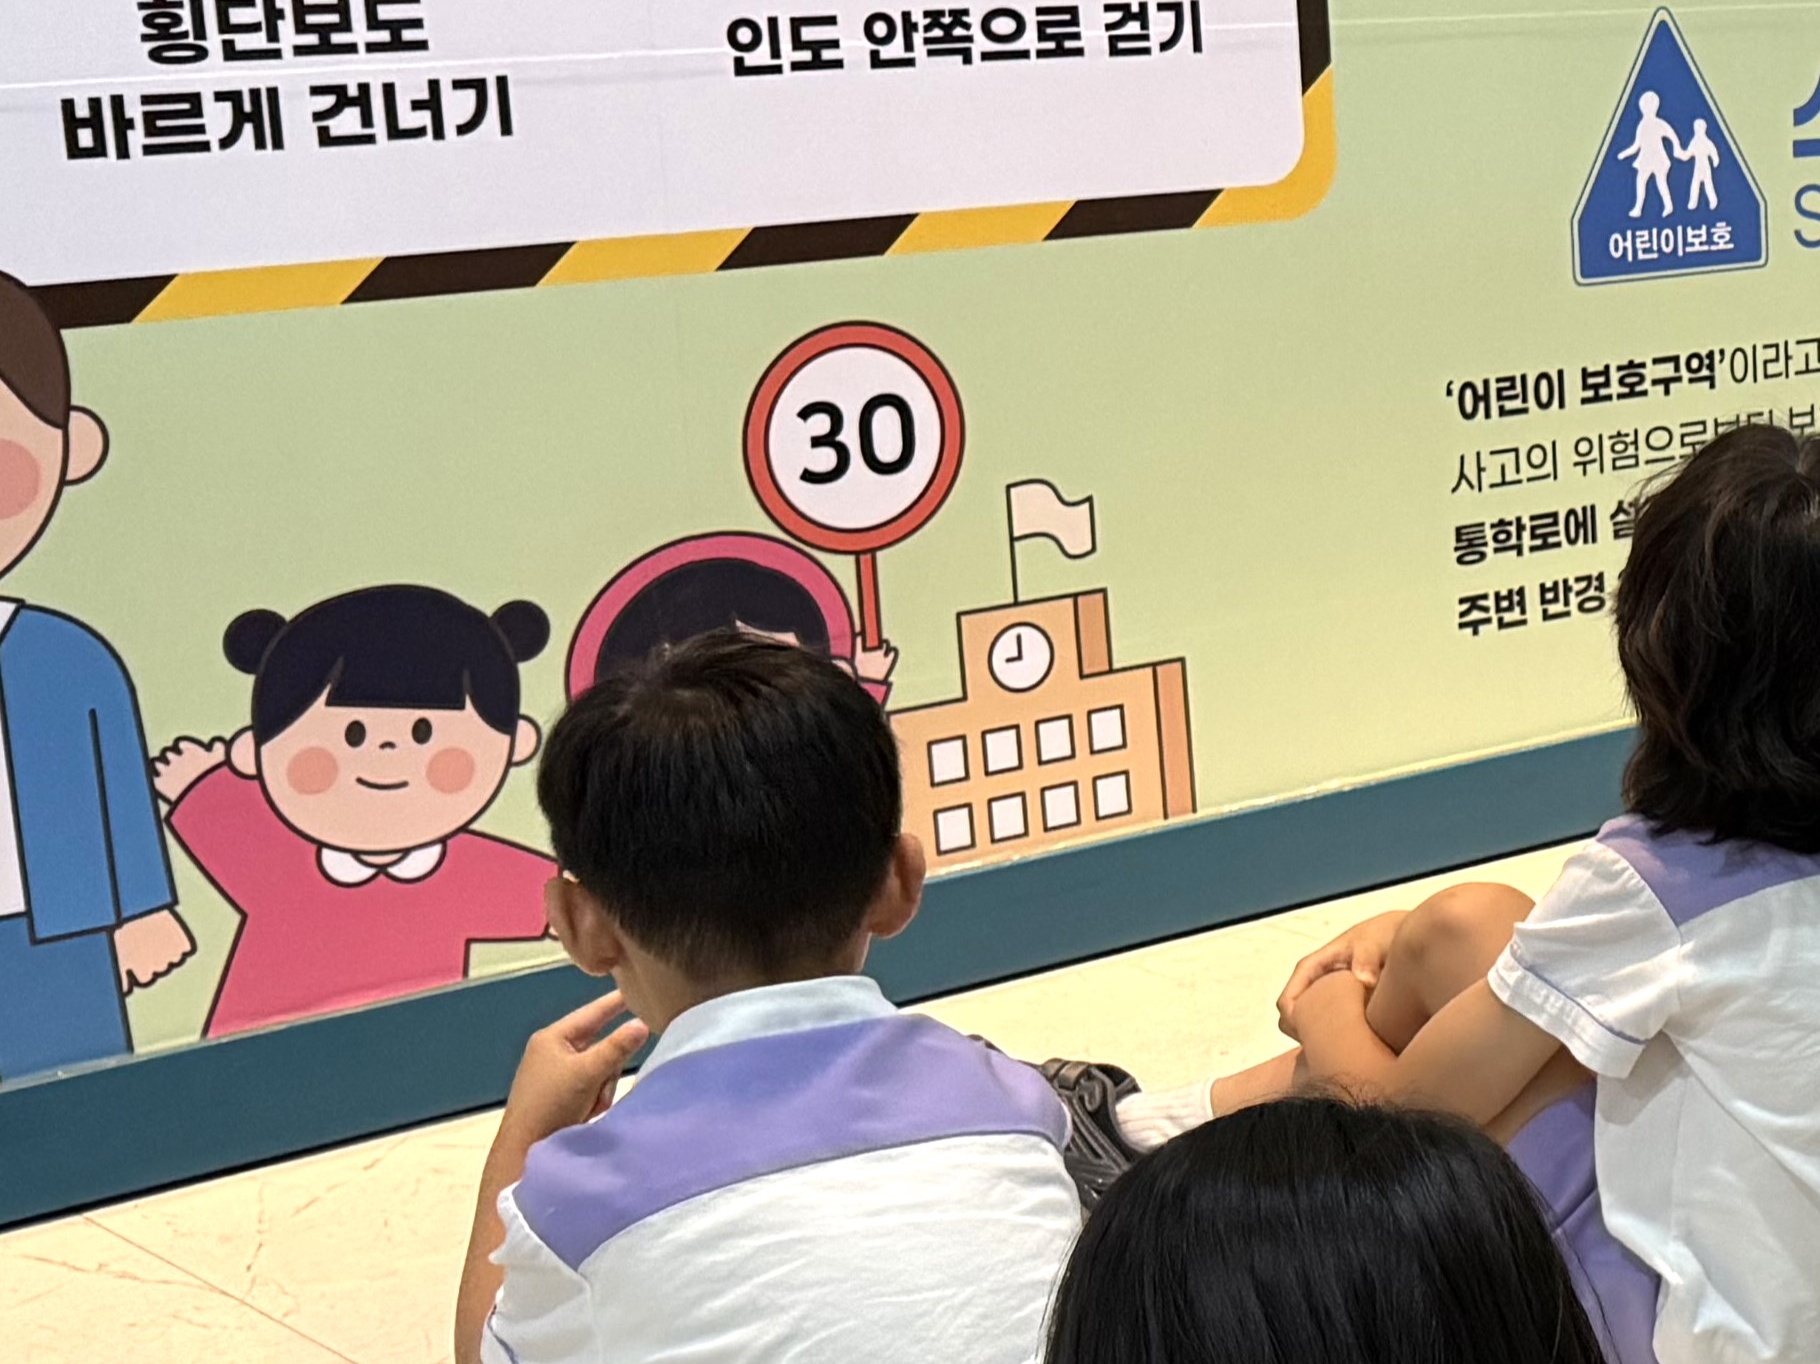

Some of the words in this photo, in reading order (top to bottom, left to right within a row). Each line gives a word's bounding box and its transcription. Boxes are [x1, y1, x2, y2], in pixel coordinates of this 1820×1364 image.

[725, 14, 847, 79] 인도
[865, 6, 1085, 69] 안쪽으로
[1102, 0, 1206, 60] 걷기
[61, 85, 286, 165] 바르게
[310, 75, 516, 152] 건너기
[1608, 222, 1735, 265] 어린이보호
[797, 391, 916, 485] 30
[1451, 439, 1559, 495] 사고의
[1453, 504, 1599, 567] 통학로에
[1457, 585, 1529, 637] 주변
[1539, 571, 1607, 622] 반경
